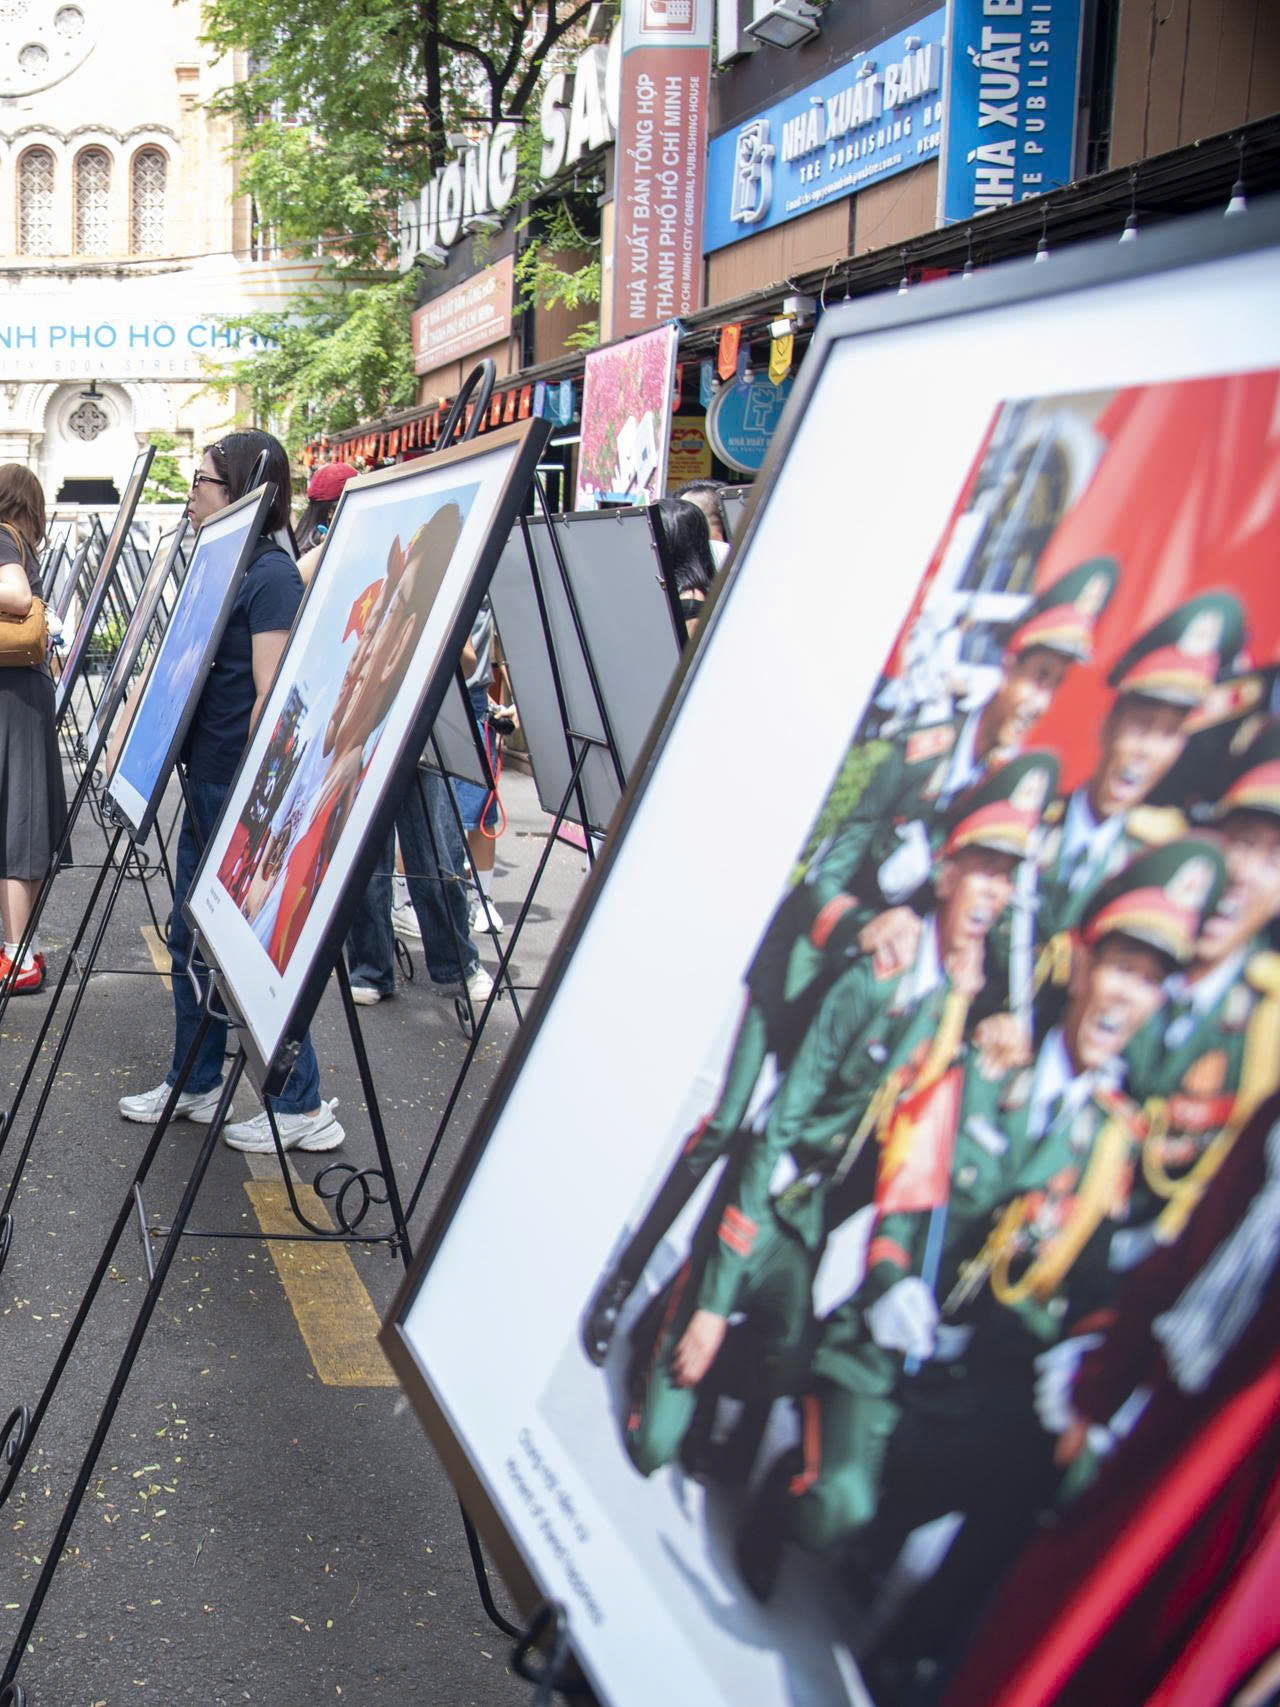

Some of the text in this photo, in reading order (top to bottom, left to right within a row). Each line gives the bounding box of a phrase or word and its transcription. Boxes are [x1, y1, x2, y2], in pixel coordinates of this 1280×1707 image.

[688, 76, 700, 113] HOUSE
[781, 36, 941, 162] NHÀ XUẤT BẢN
[967, 26, 1022, 128] XUẤT
[686, 114, 698, 177] PUBLISHING
[800, 160, 821, 184] TRE
[829, 115, 912, 171] PUBLISHING
[625, 73, 658, 319] NHÀ XUẤT BẢN TỔNG HỢP
[653, 76, 682, 319] THÀNH PHỐ HỒ CHÍ MINH
[684, 179, 696, 226] GENERAL
[681, 252, 692, 280] MINH
[682, 227, 694, 250] CITY
[681, 280, 691, 300] CHI
